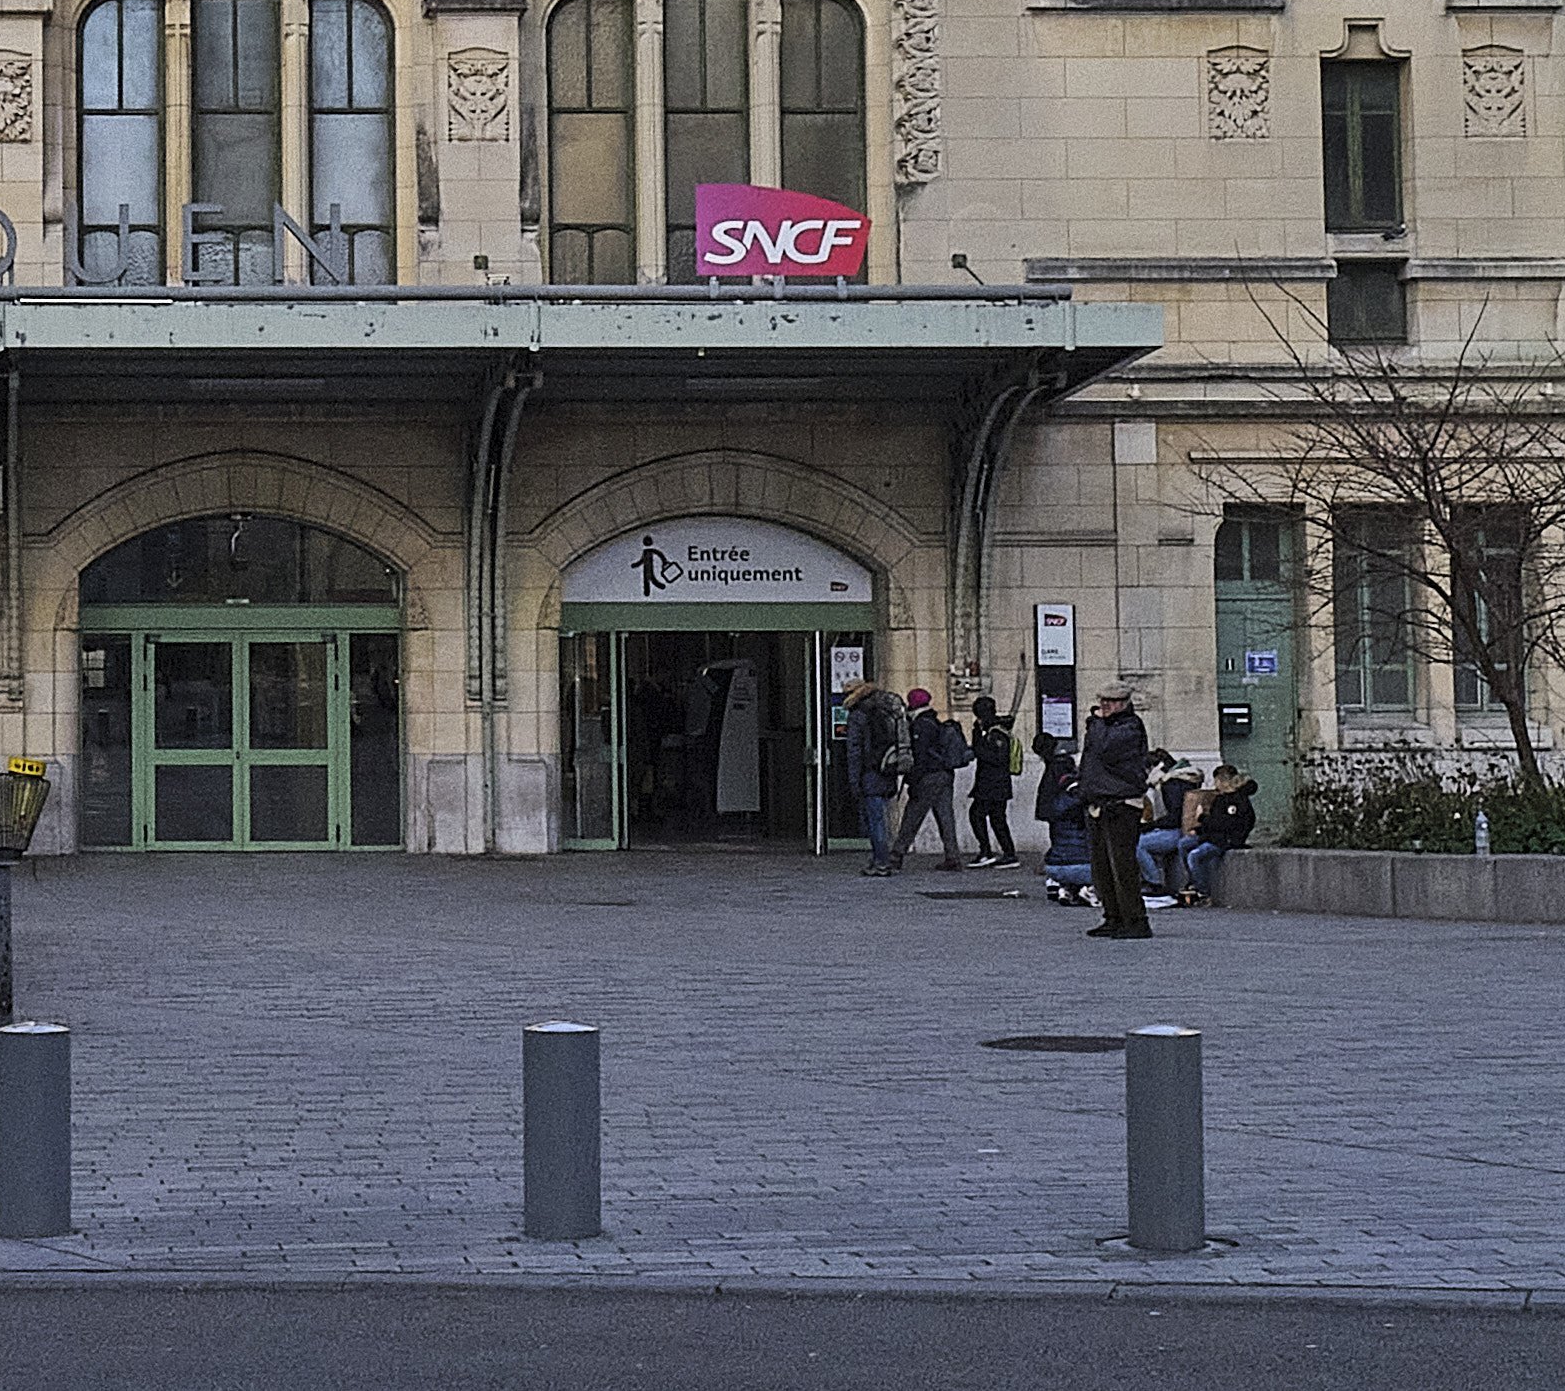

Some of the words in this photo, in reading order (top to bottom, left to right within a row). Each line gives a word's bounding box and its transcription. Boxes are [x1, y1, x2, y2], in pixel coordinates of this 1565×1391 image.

[704, 220, 861, 264] SNCF
[688, 545, 750, 562] Entrée
[688, 565, 802, 585] uniquement
